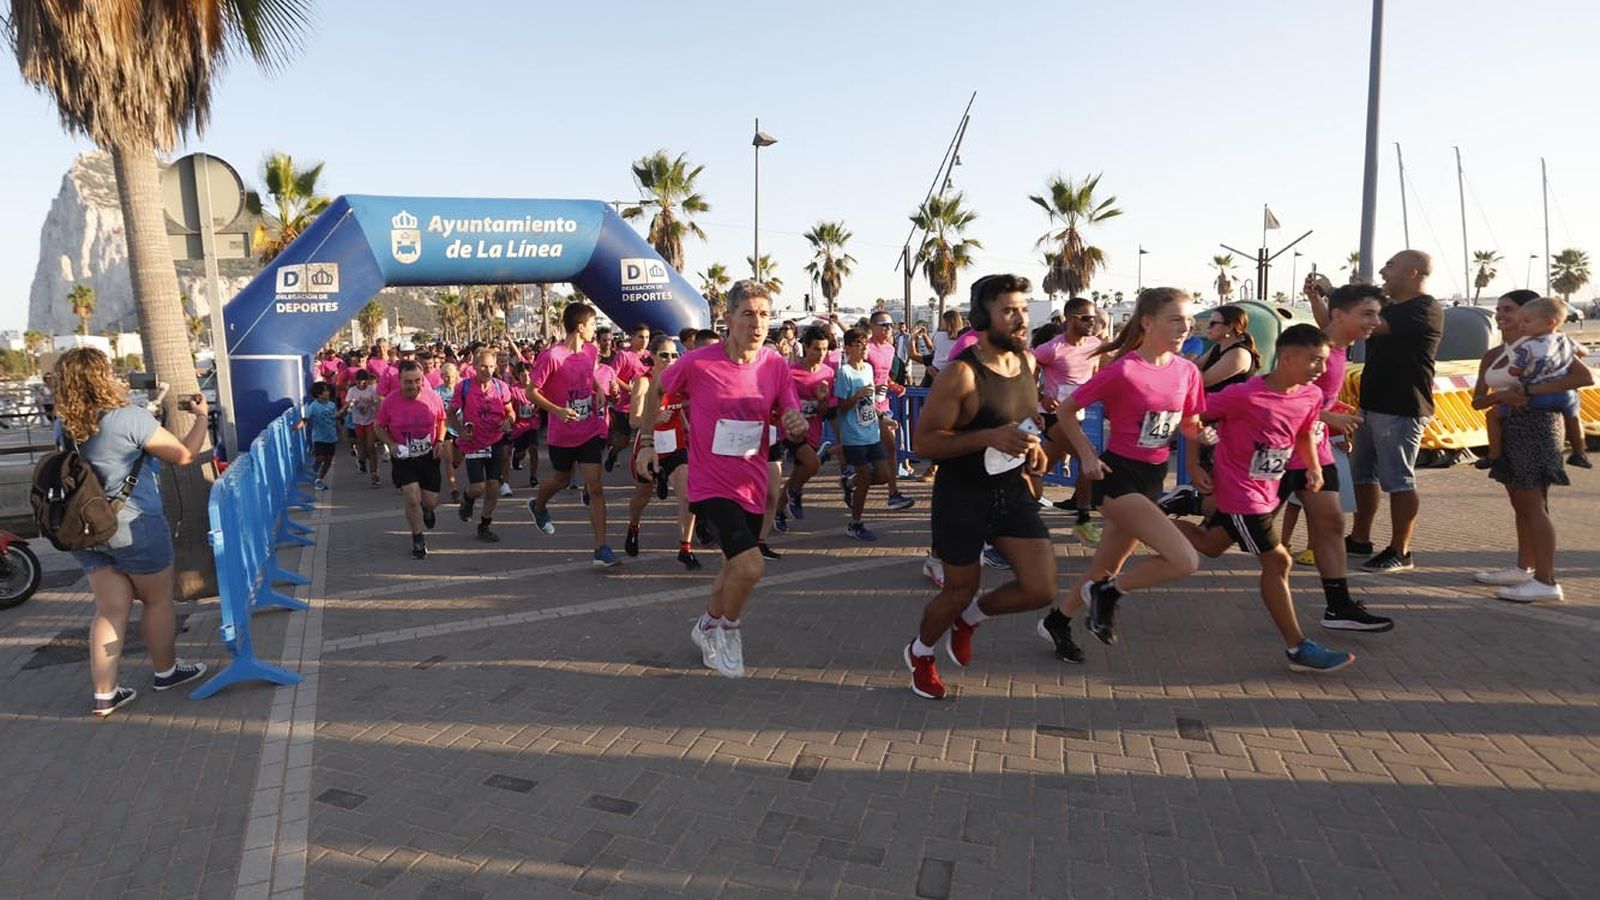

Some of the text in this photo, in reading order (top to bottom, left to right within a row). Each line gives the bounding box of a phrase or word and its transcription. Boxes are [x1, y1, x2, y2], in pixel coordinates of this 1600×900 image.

[428, 215, 577, 238] Ayuntamiento
[445, 238, 564, 259] de La Línea
[283, 270, 300, 287] D
[627, 264, 641, 280] D
[622, 291, 673, 302] DEPORTES
[276, 302, 339, 313] DEPORTES
[1149, 422, 1170, 438] 49
[1259, 458, 1283, 473] 42
